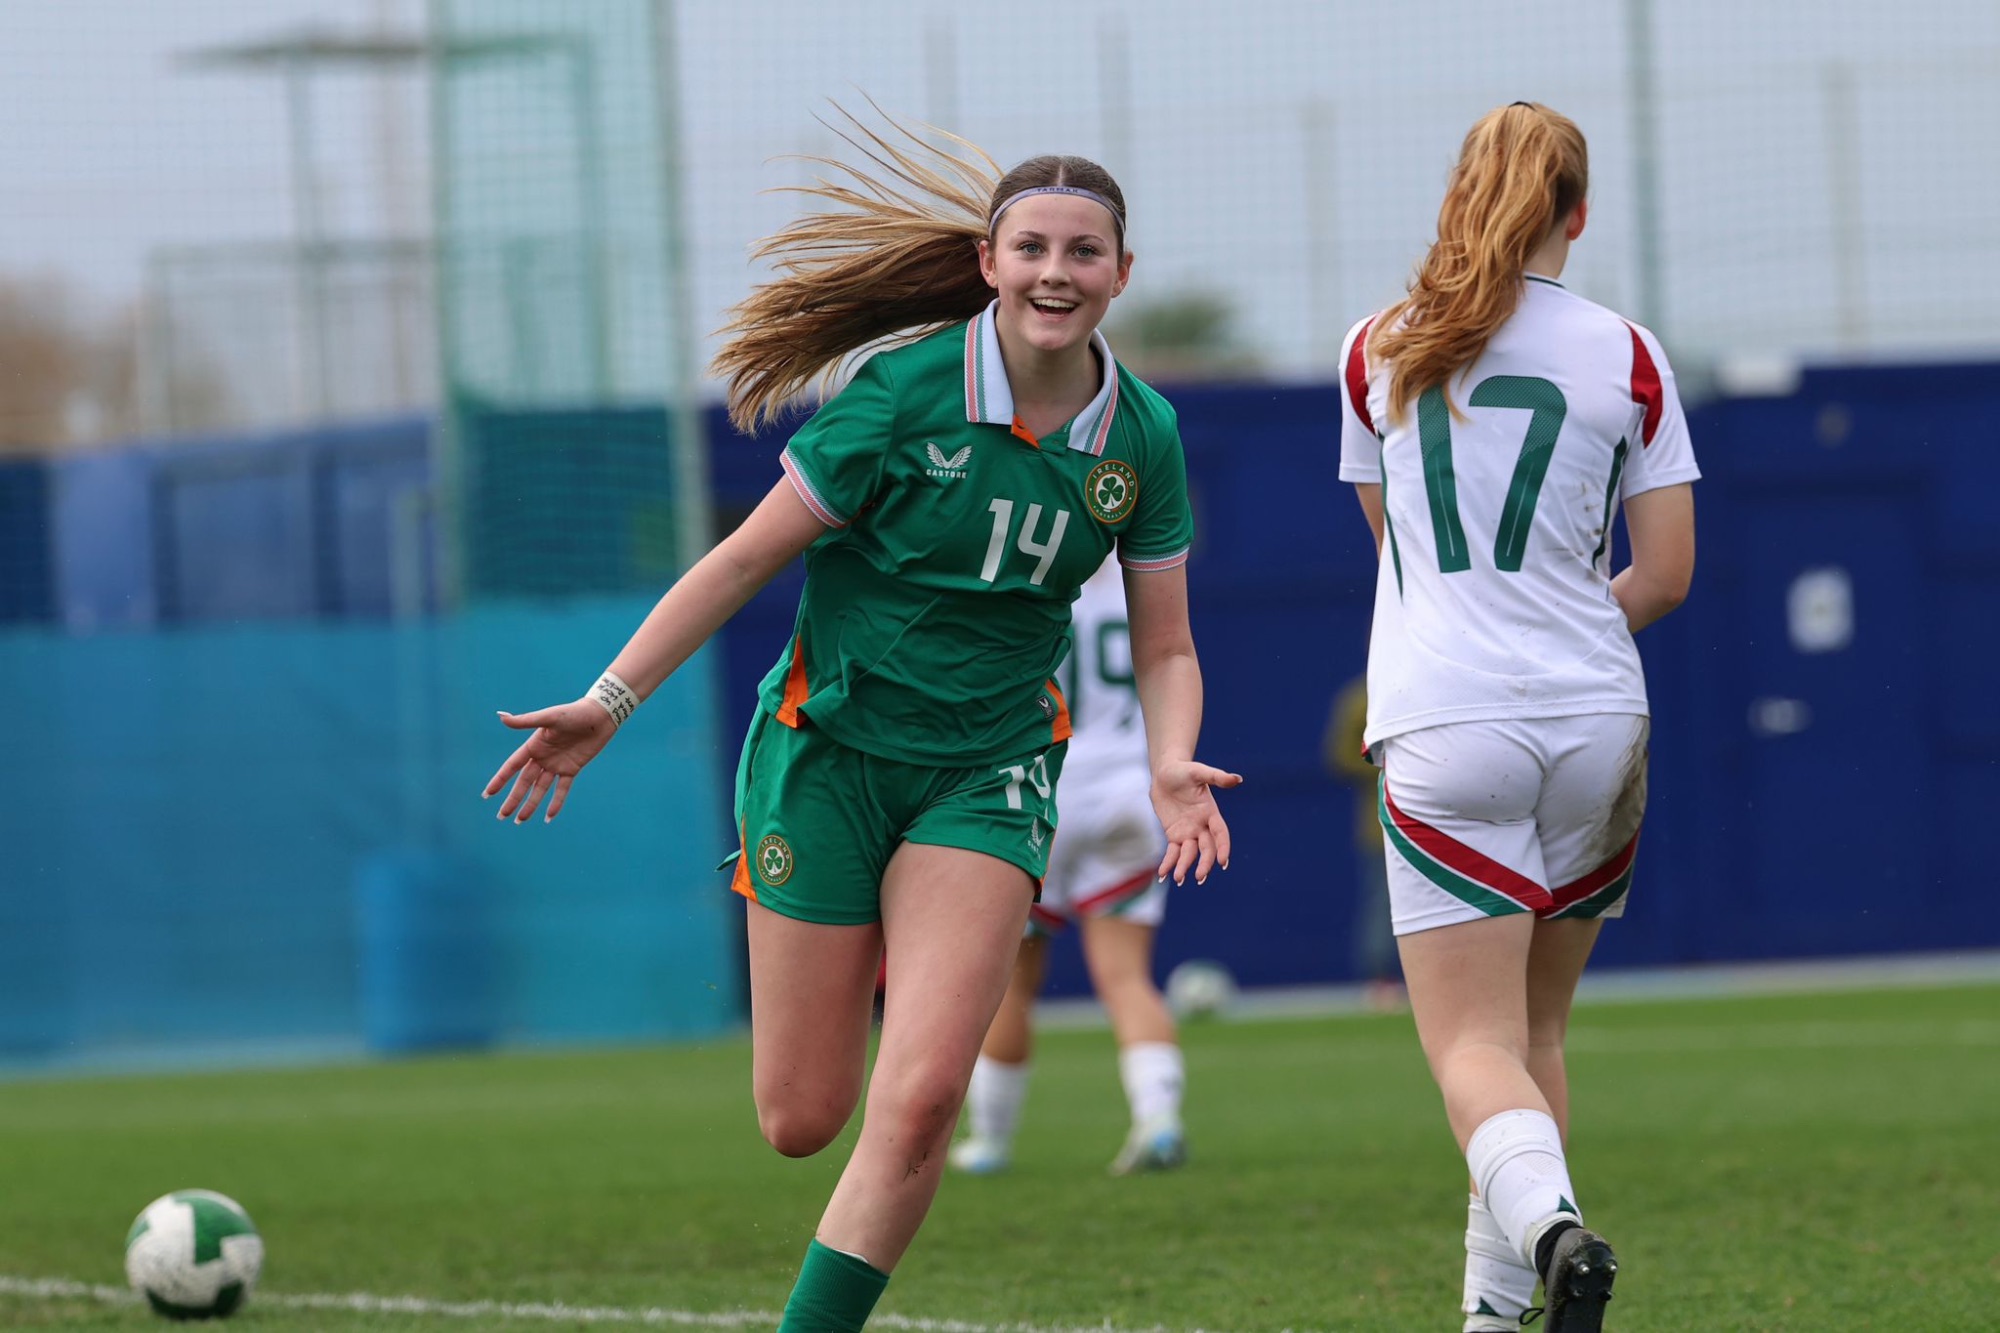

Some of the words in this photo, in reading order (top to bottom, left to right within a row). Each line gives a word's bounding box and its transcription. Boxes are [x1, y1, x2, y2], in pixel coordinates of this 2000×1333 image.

[926, 469, 967, 479] CASTORE
[1092, 463, 1135, 487] IRELAND
[1417, 375, 1567, 573] 17
[980, 498, 1070, 586] 14
[761, 838, 790, 860] IRELAND
